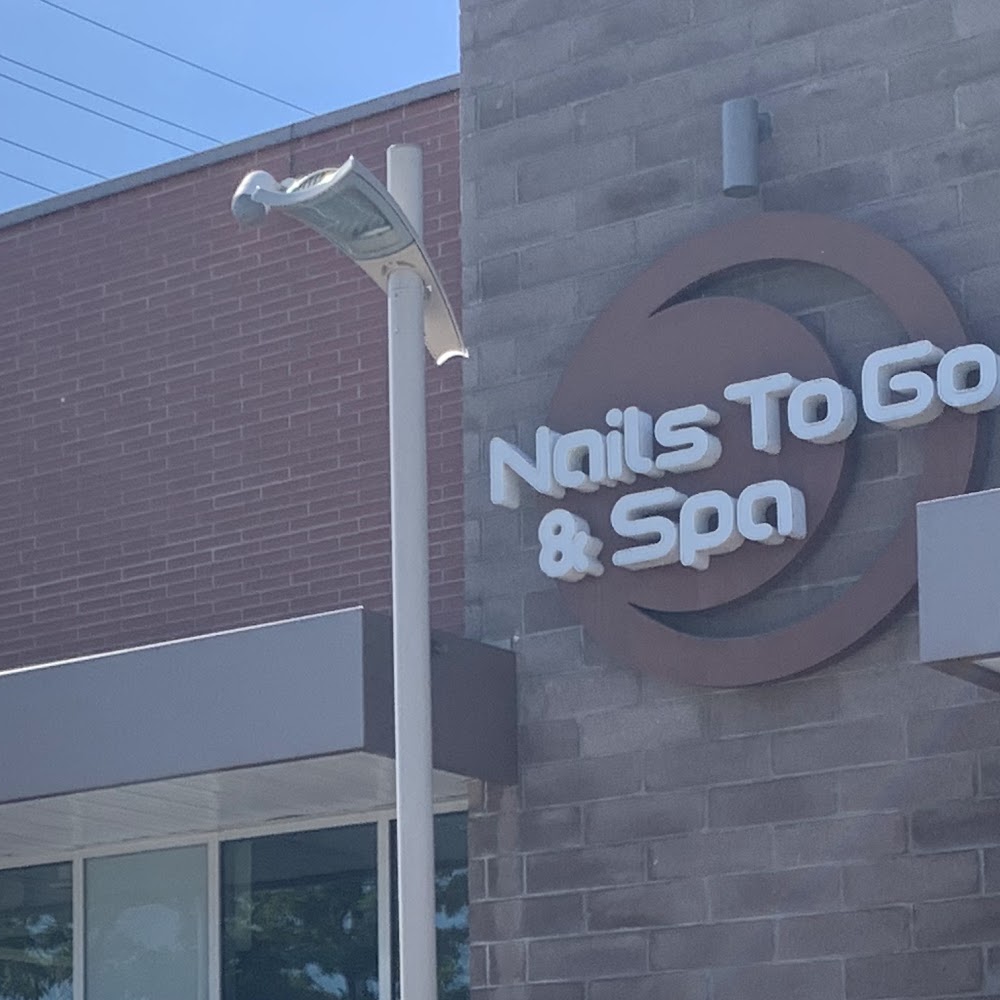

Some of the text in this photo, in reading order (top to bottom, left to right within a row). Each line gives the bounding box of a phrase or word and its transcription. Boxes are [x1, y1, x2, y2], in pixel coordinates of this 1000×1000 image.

[488, 403, 722, 507] Nails
[537, 479, 807, 583] & Spa
